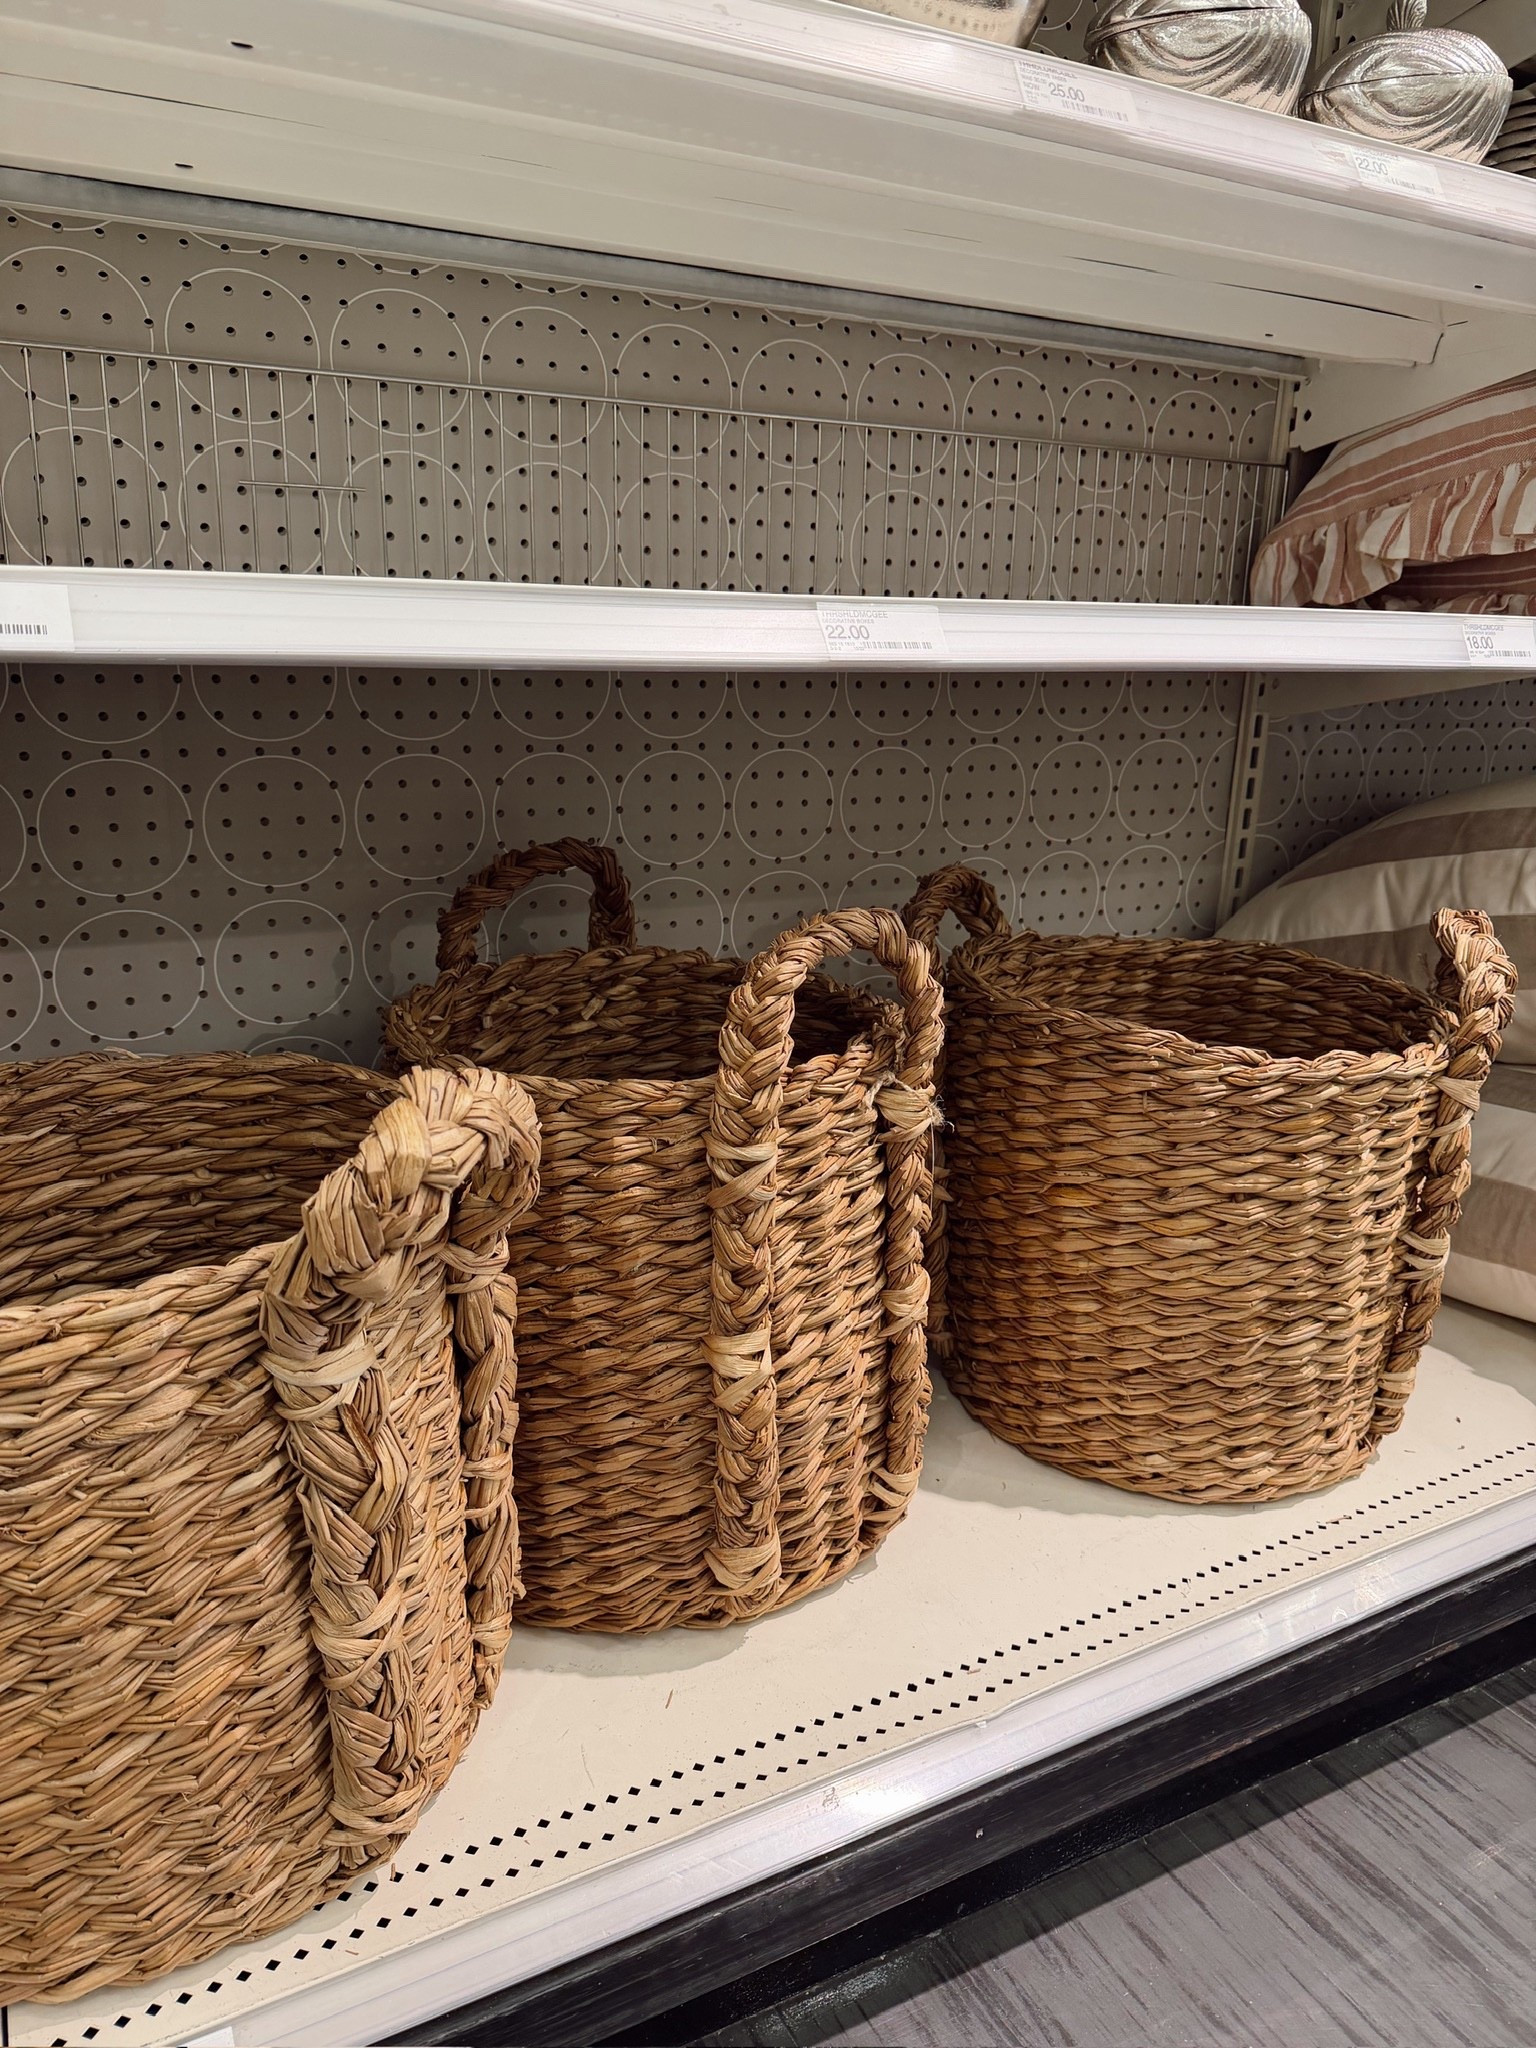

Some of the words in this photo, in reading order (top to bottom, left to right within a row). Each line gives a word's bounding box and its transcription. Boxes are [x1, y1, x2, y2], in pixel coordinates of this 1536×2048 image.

[1048, 82, 1085, 102] 25.00
[1355, 157, 1388, 175] 22.00
[825, 625, 870, 639] 22.00
[1466, 635, 1494, 649] 18.00
